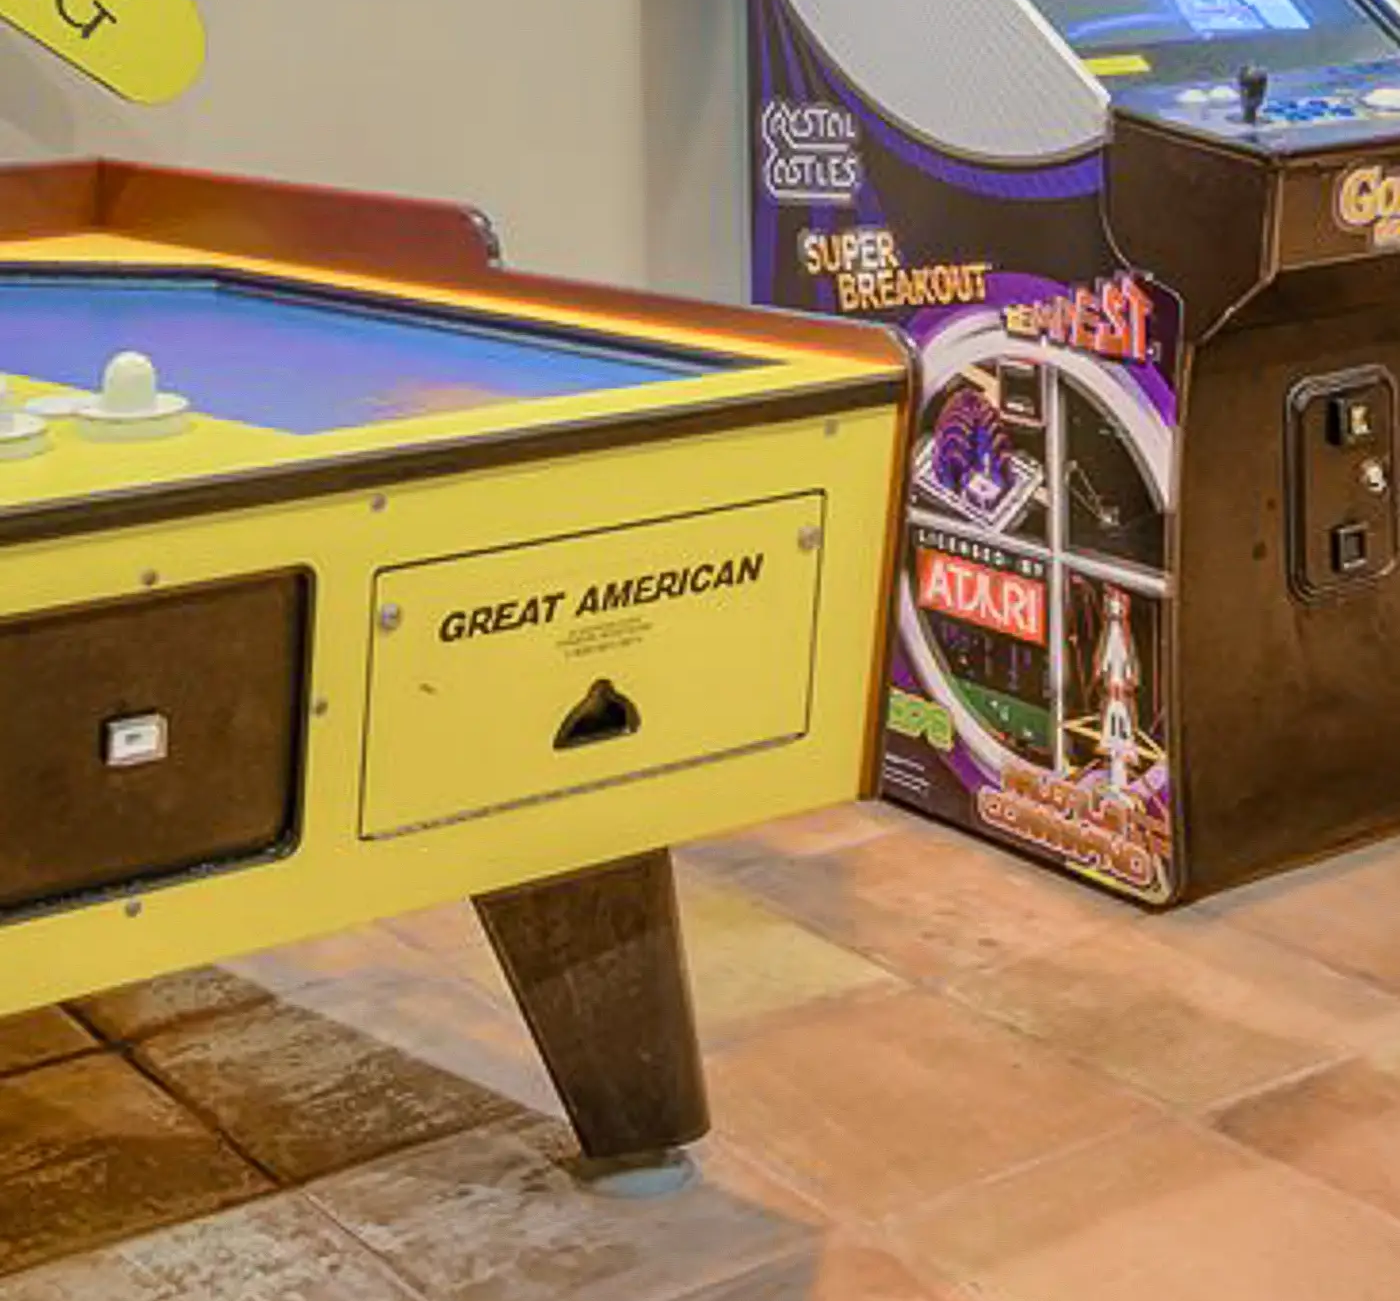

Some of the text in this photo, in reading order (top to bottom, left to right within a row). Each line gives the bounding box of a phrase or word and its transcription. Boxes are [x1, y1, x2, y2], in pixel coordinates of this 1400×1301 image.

[802, 230, 900, 275] SUPER
[837, 262, 992, 312] BREAKOUT
[439, 593, 565, 642] GREAT
[575, 553, 764, 617] AMERICAN
[925, 558, 1038, 636] ATARI
